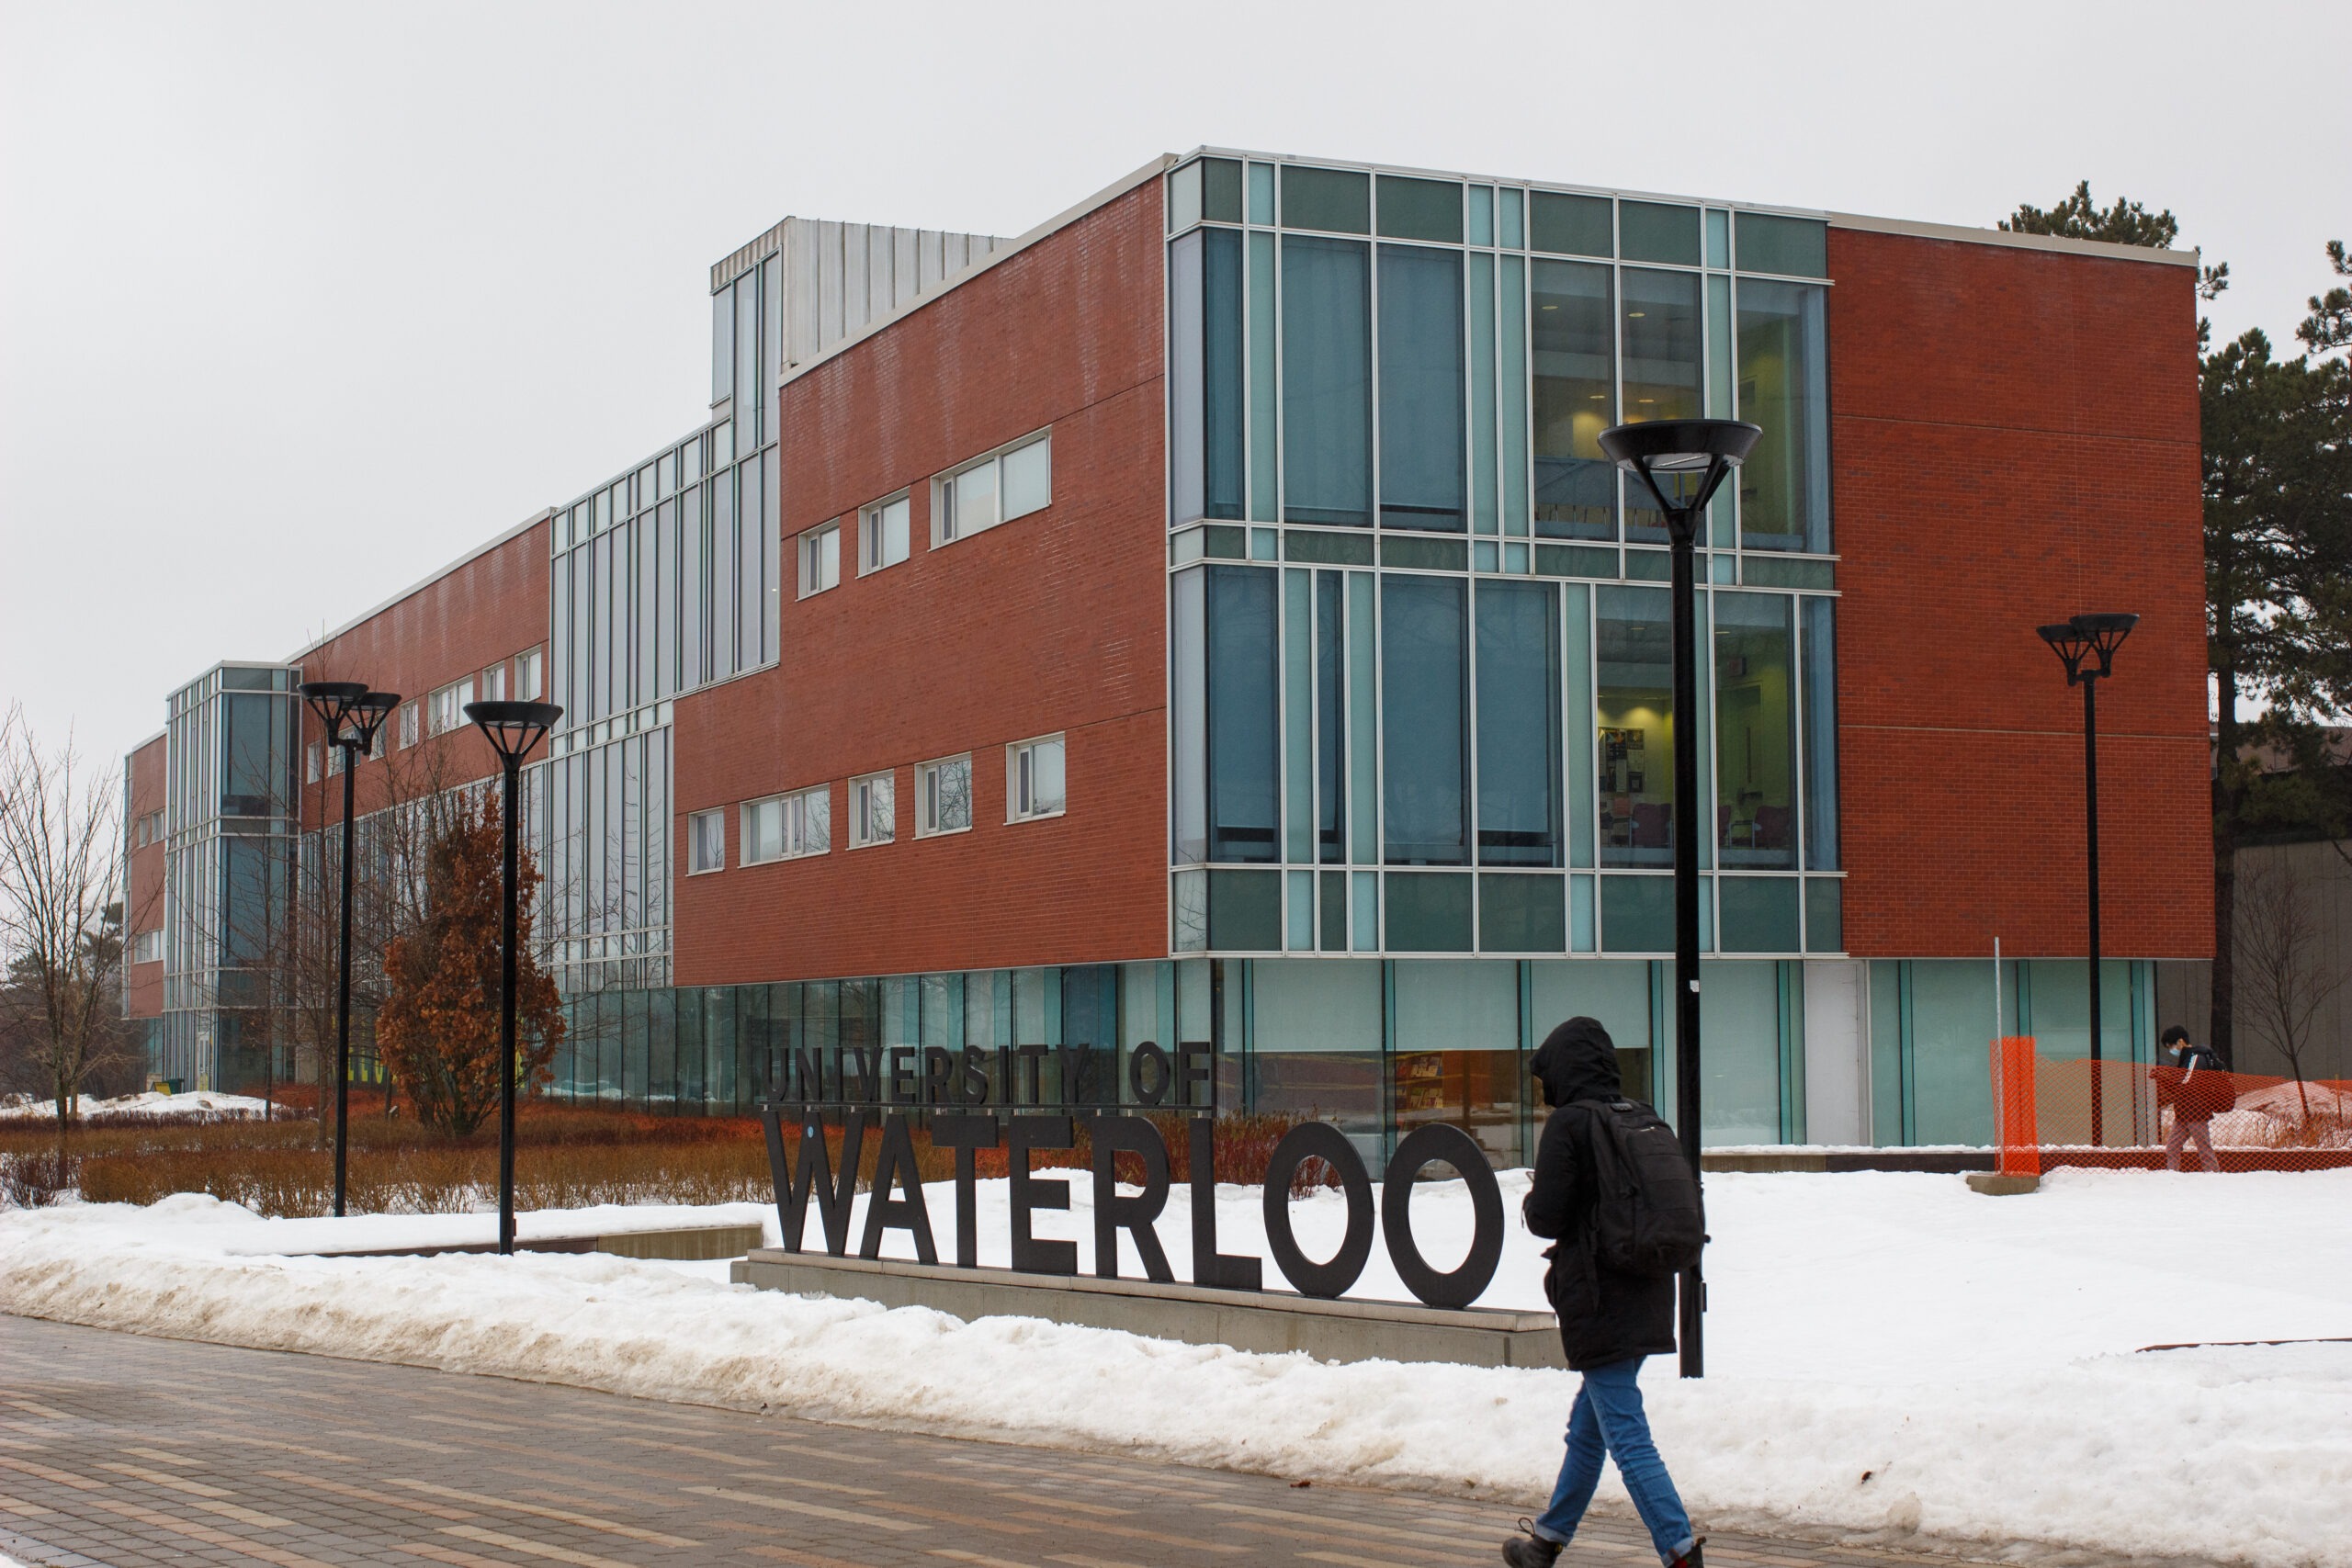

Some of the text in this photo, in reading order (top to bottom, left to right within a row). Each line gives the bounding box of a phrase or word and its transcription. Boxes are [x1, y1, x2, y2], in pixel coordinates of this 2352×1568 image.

[763, 1041, 1210, 1105] UNIVERSITY OF
[763, 1111, 1504, 1309] WATERLOO
